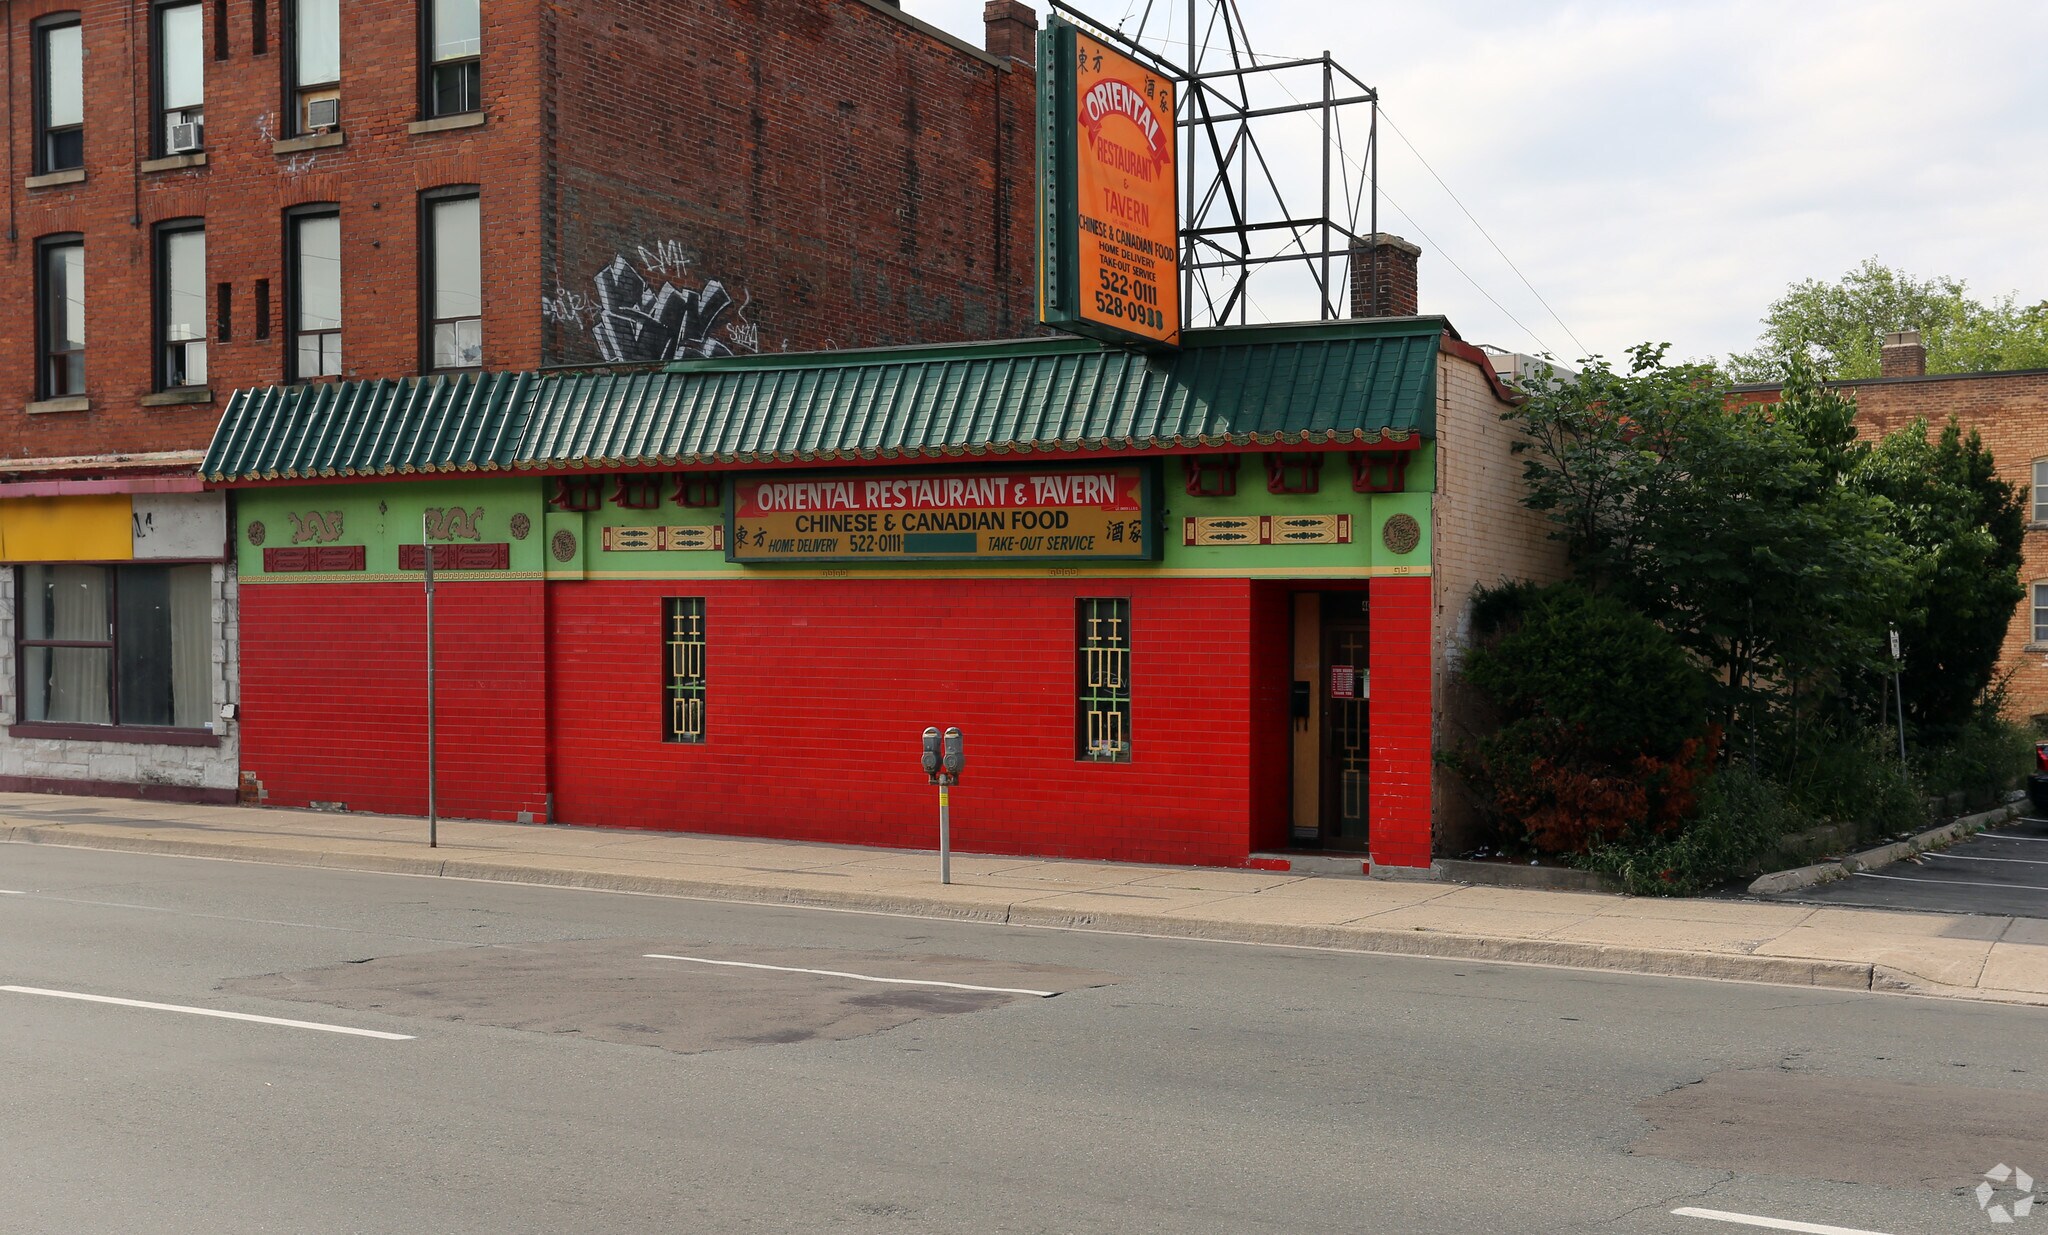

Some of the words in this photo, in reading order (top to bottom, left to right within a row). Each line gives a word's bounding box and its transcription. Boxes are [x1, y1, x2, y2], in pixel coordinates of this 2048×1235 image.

[1078, 47, 1103, 75] 東方
[1144, 74, 1169, 113] 酒家
[1086, 82, 1159, 151] ORIENTAL
[1097, 136, 1153, 182] RESTAURANT
[1104, 187, 1149, 228] TAVERN
[1079, 214, 1107, 238] CHINESE
[1109, 225, 1115, 241] &
[1116, 228, 1153, 255] CANADIAN
[1155, 243, 1174, 262] FOOD
[1099, 241, 1119, 256] HOME
[1121, 249, 1155, 269] DELIVERY
[1099, 254, 1130, 273] TAKE-OUT
[1132, 265, 1156, 282] SERVICE
[757, 482, 860, 511] ORIENTAL
[865, 478, 1009, 508] RESTAURANT
[1014, 483, 1027, 505] &
[1030, 475, 1115, 505] TAVERN
[795, 514, 877, 533] CHINESE
[884, 514, 896, 531] &
[901, 512, 1005, 531] CANADIAN
[1012, 511, 1069, 530] FOOD
[1106, 520, 1142, 543] 酒家
[735, 525, 767, 549] 東方
[768, 538, 795, 553] HOME
[796, 538, 839, 553] DELIVERY
[988, 536, 1044, 551] TAKE-OUT
[1046, 535, 1095, 551] SERVICE
